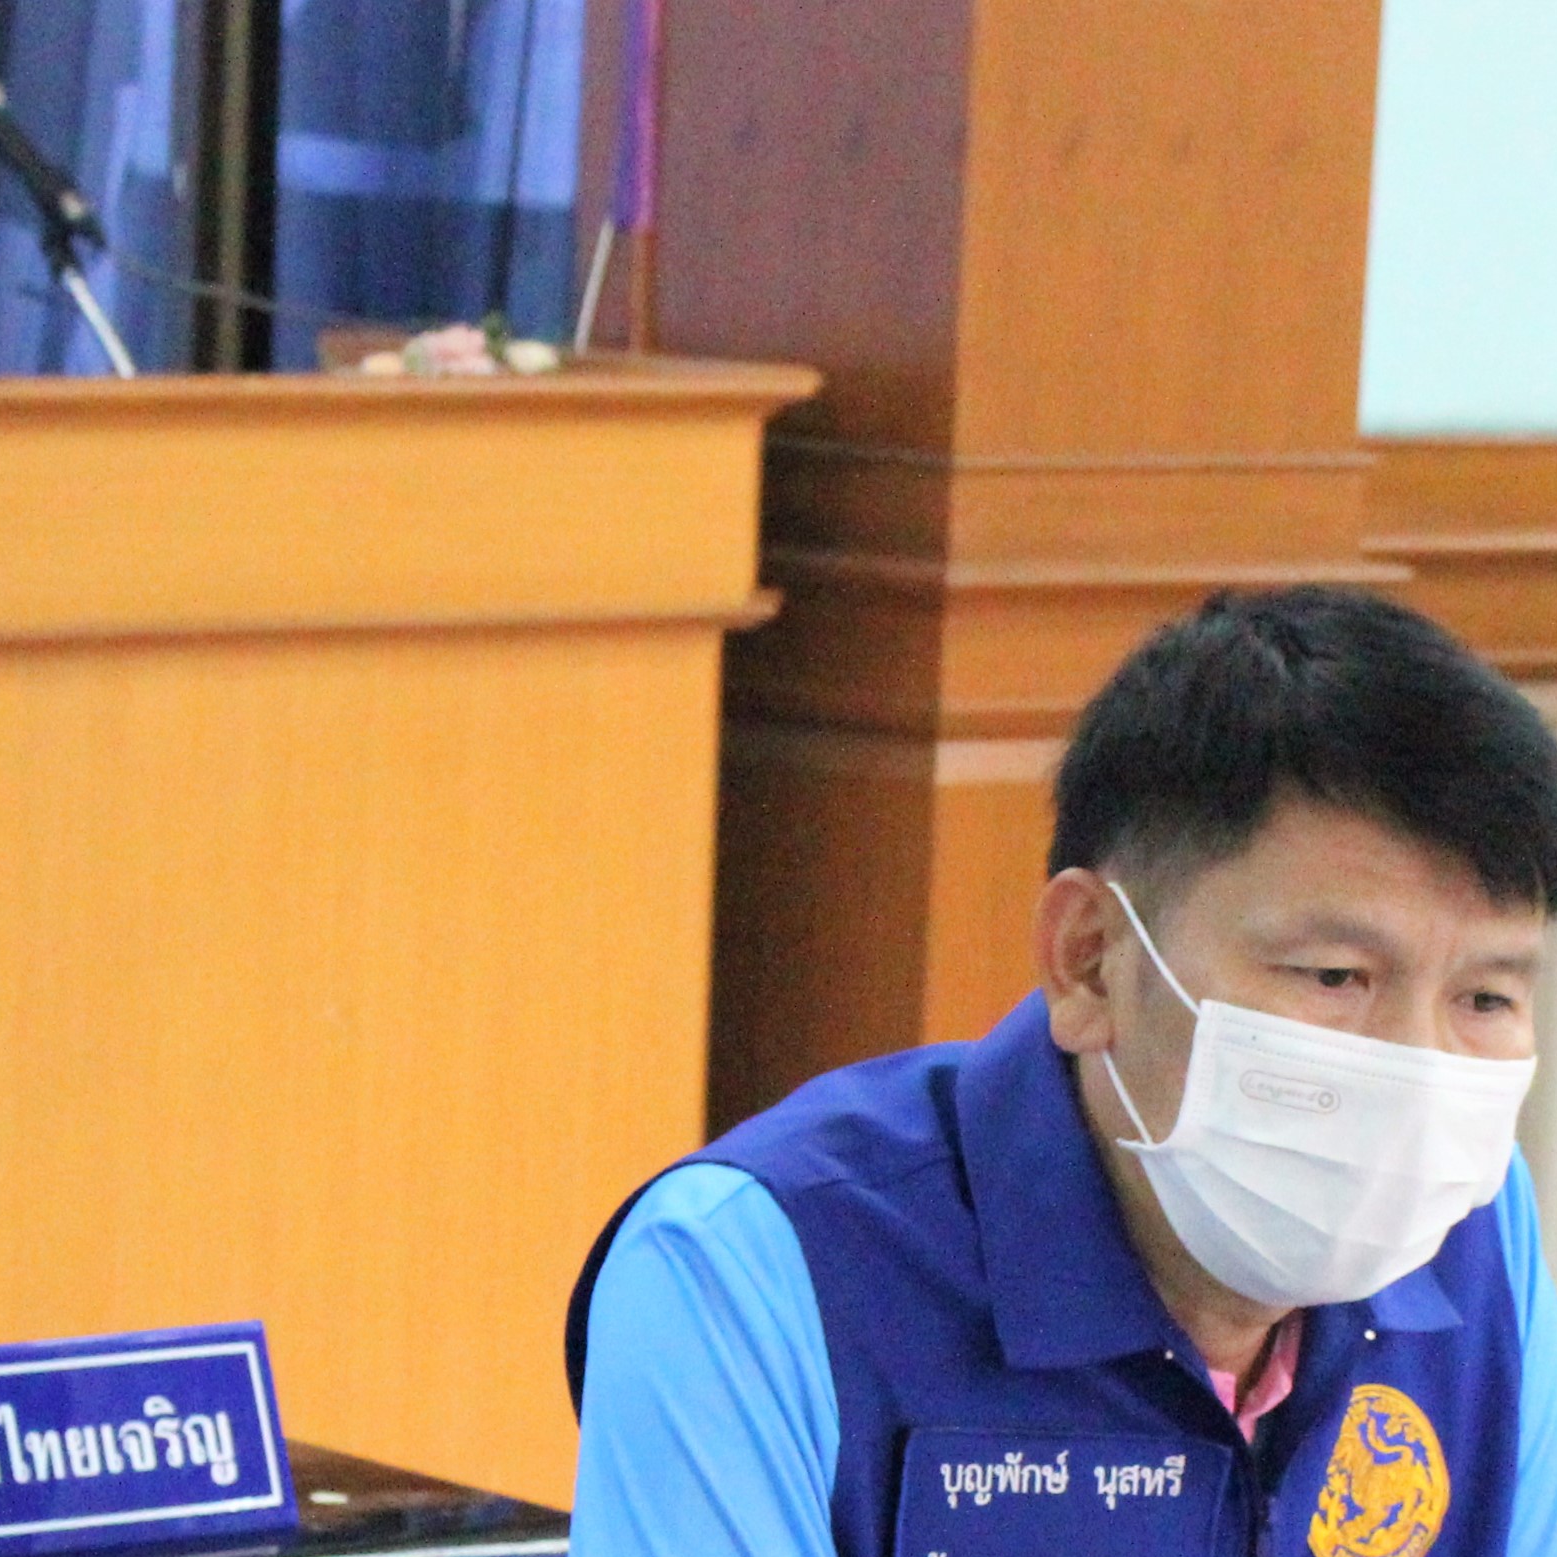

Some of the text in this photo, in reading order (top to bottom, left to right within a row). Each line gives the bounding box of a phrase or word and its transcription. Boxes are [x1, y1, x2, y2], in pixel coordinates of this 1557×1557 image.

[940, 1449, 1186, 1511] บุญพักษ์ นุสทรี
